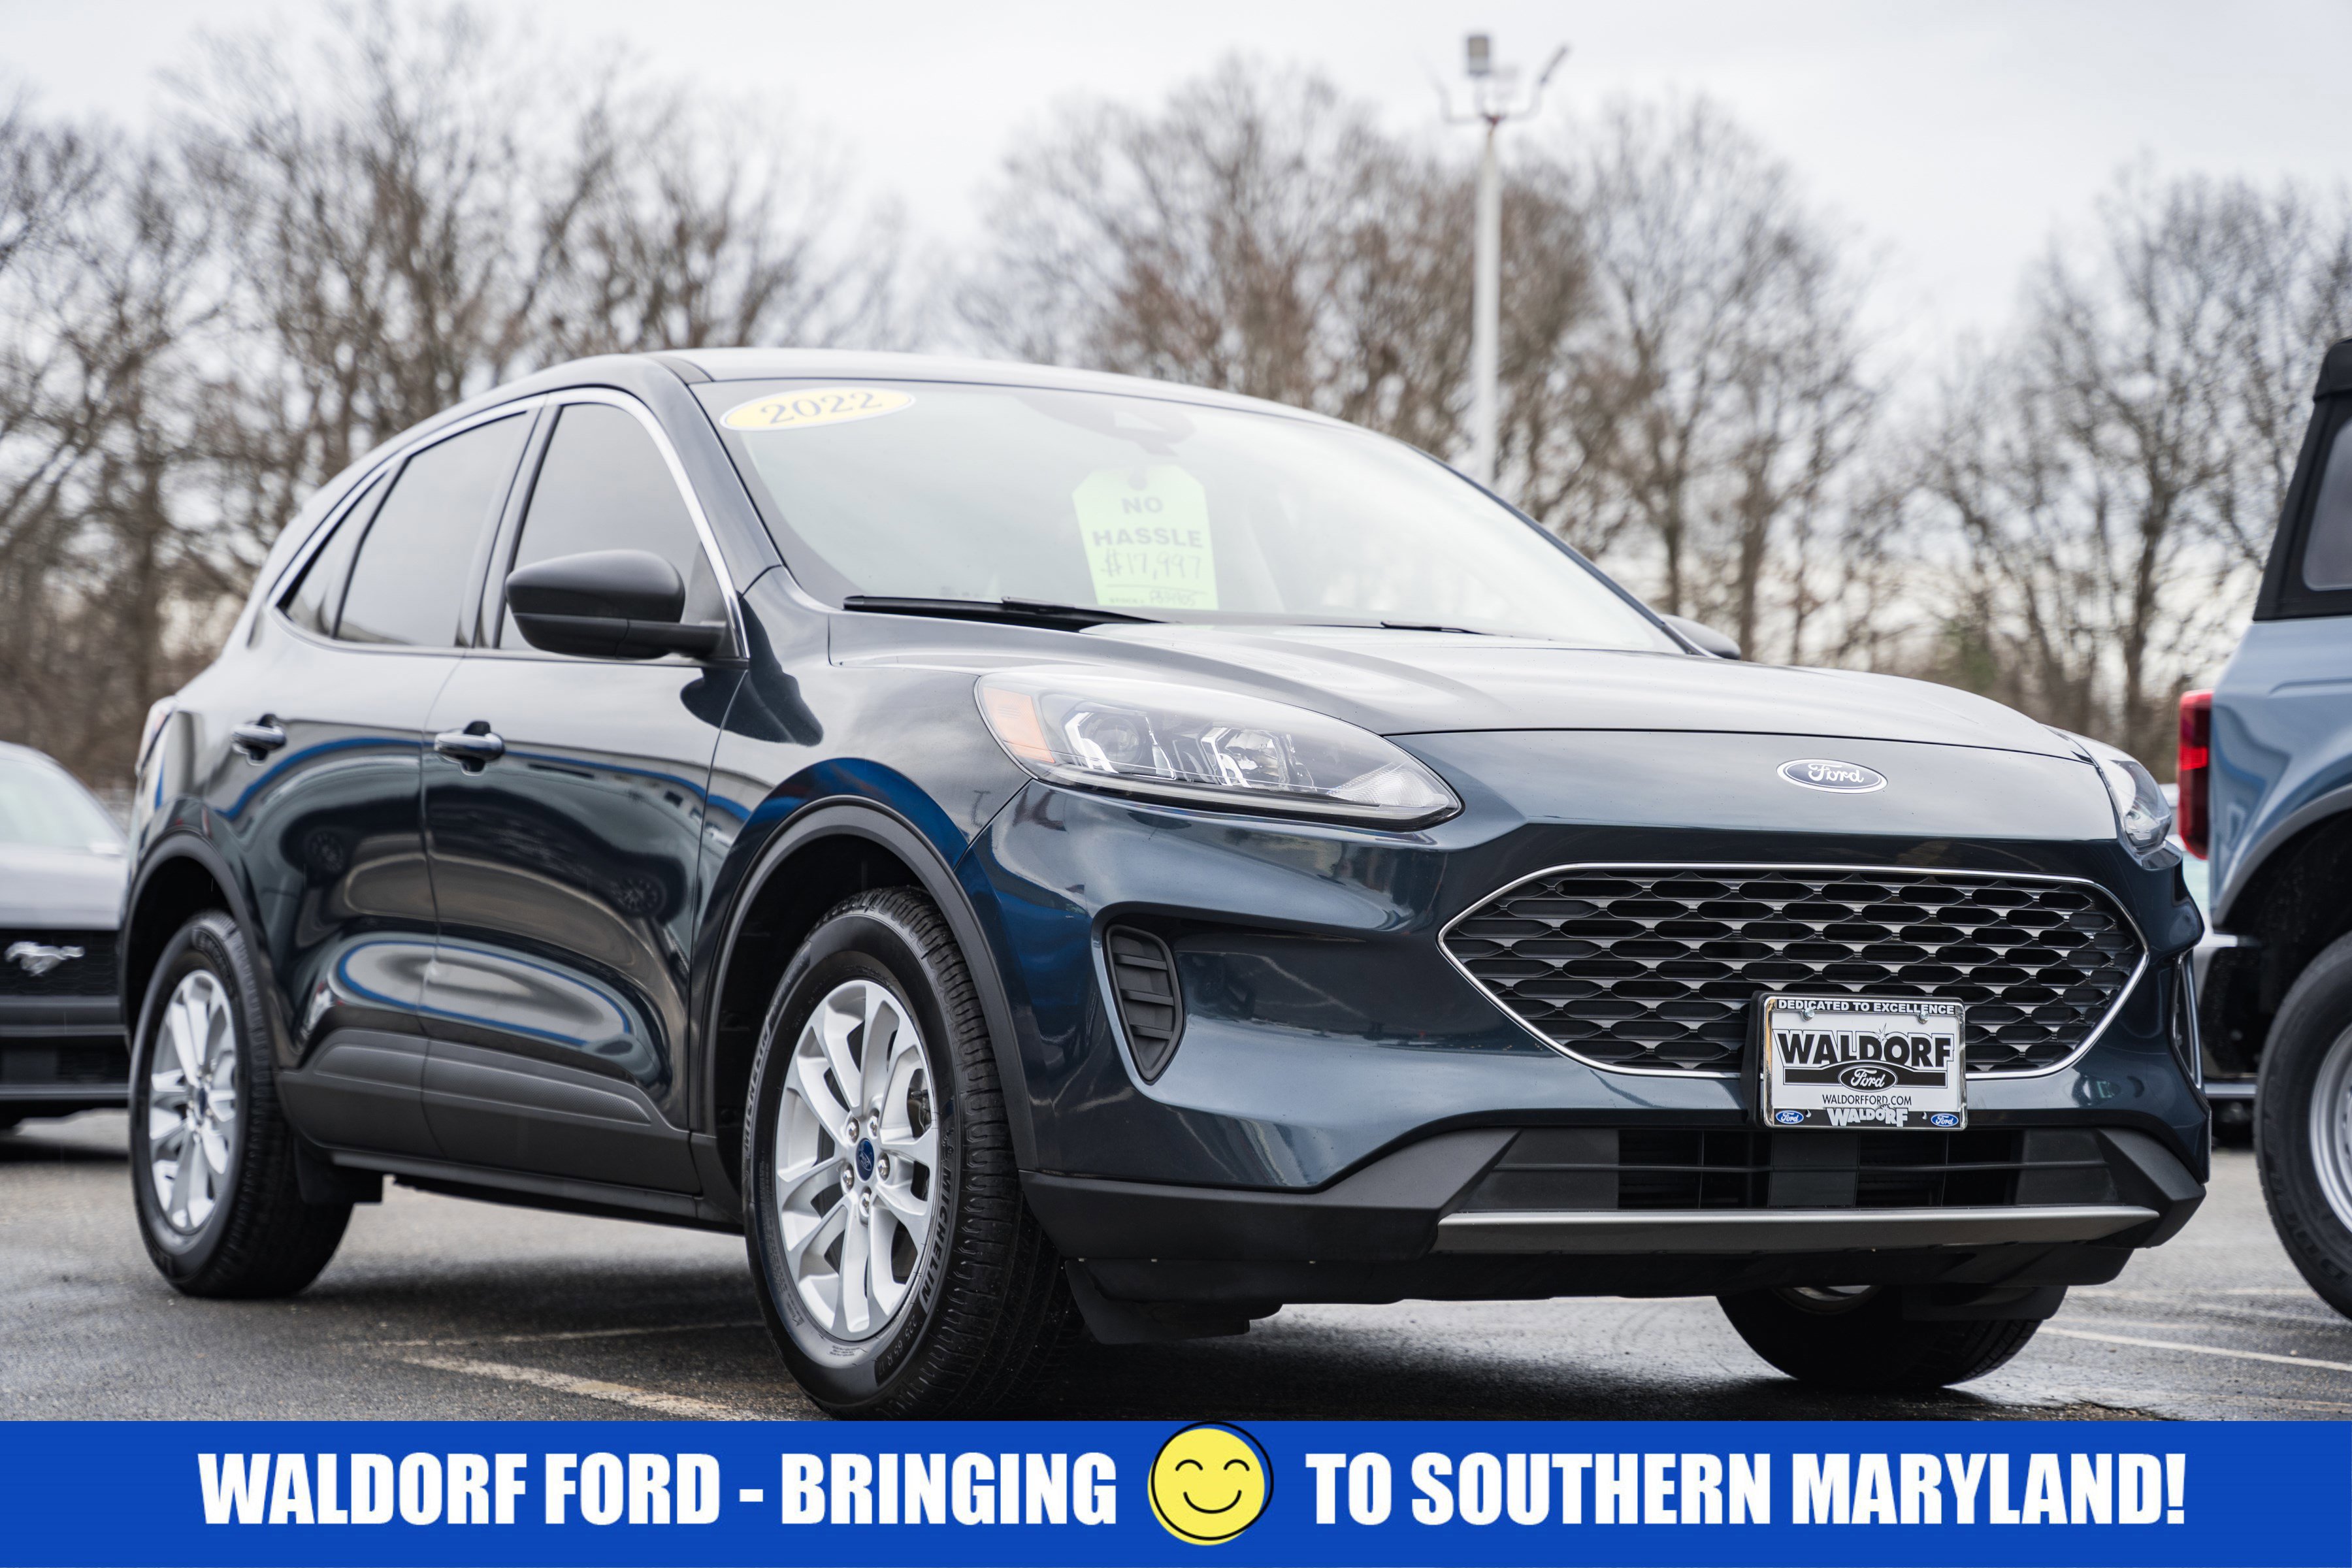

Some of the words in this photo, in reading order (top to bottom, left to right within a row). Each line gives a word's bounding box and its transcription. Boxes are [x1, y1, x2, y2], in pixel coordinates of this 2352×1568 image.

[760, 391, 883, 424] 2022
[1121, 496, 1164, 514] NO
[1092, 527, 1203, 549] HASSLE
[1100, 547, 1202, 580] $17,997
[1807, 763, 1865, 783] Ford
[1778, 1000, 1850, 1012] DEDICATED
[1853, 1002, 1870, 1012] TO
[1873, 1002, 1955, 1015] EXCELLENCE
[1774, 1031, 1953, 1068] WALDORF
[1850, 1068, 1886, 1088] Ford
[1821, 1094, 1912, 1106] WALDORFFORD.COM
[1780, 1112, 1800, 1124] Ford
[1825, 1107, 1909, 1128] WALDORF
[1935, 1115, 1955, 1126] Ford
[920, 1166, 952, 1304] MICHELIN
